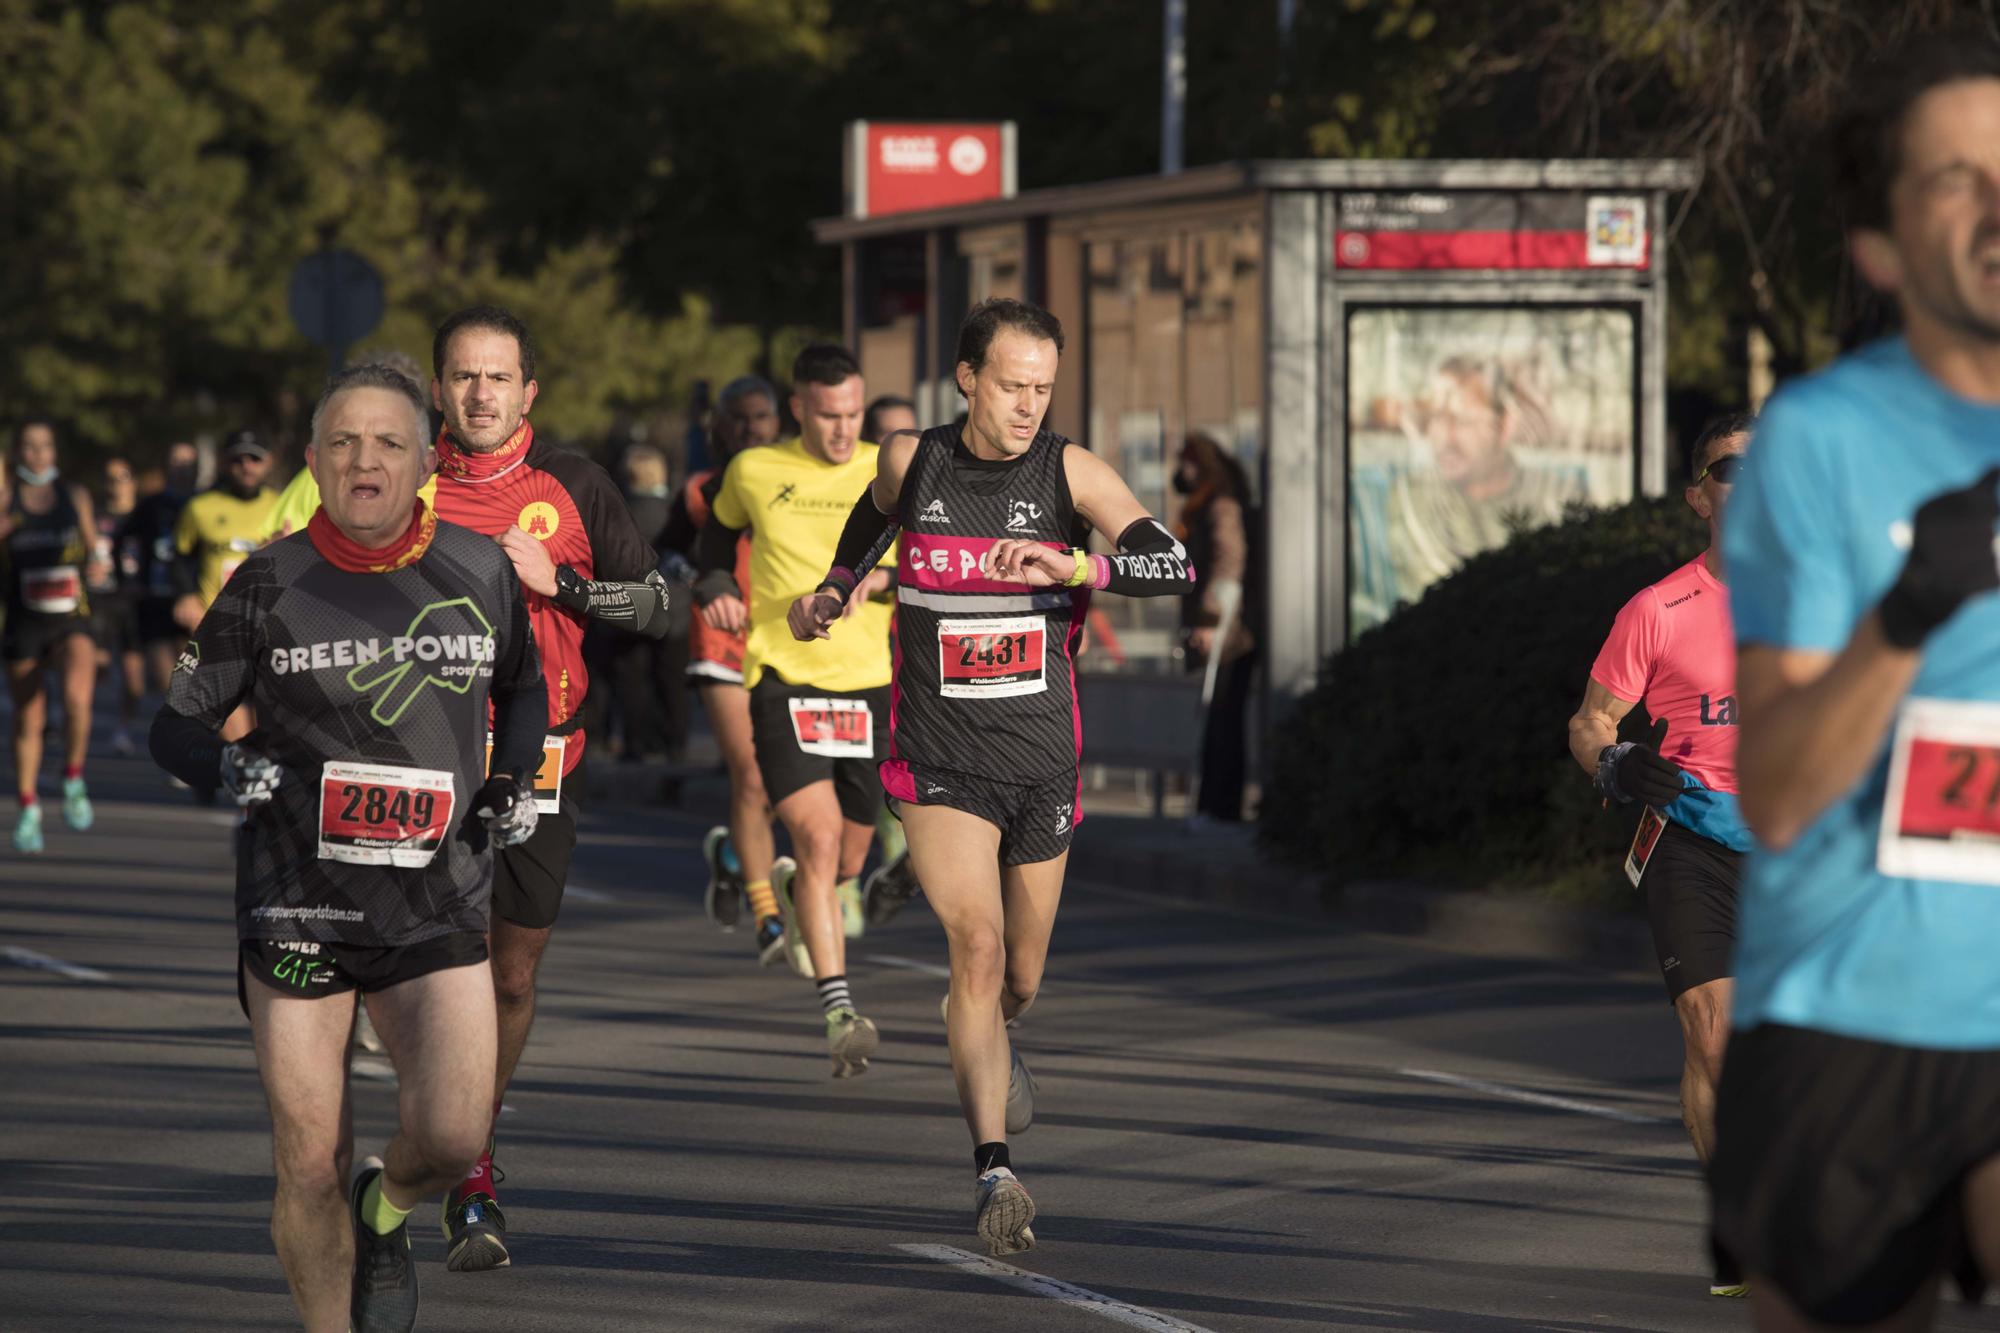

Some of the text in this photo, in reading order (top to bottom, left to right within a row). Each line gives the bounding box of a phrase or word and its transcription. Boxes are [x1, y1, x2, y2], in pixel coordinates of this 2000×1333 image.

[1665, 592, 1692, 609] luanvi
[270, 634, 496, 676] GREEN POWER
[958, 633, 1027, 667] 2431
[440, 665, 478, 677] SPORT
[340, 783, 434, 830] 2849
